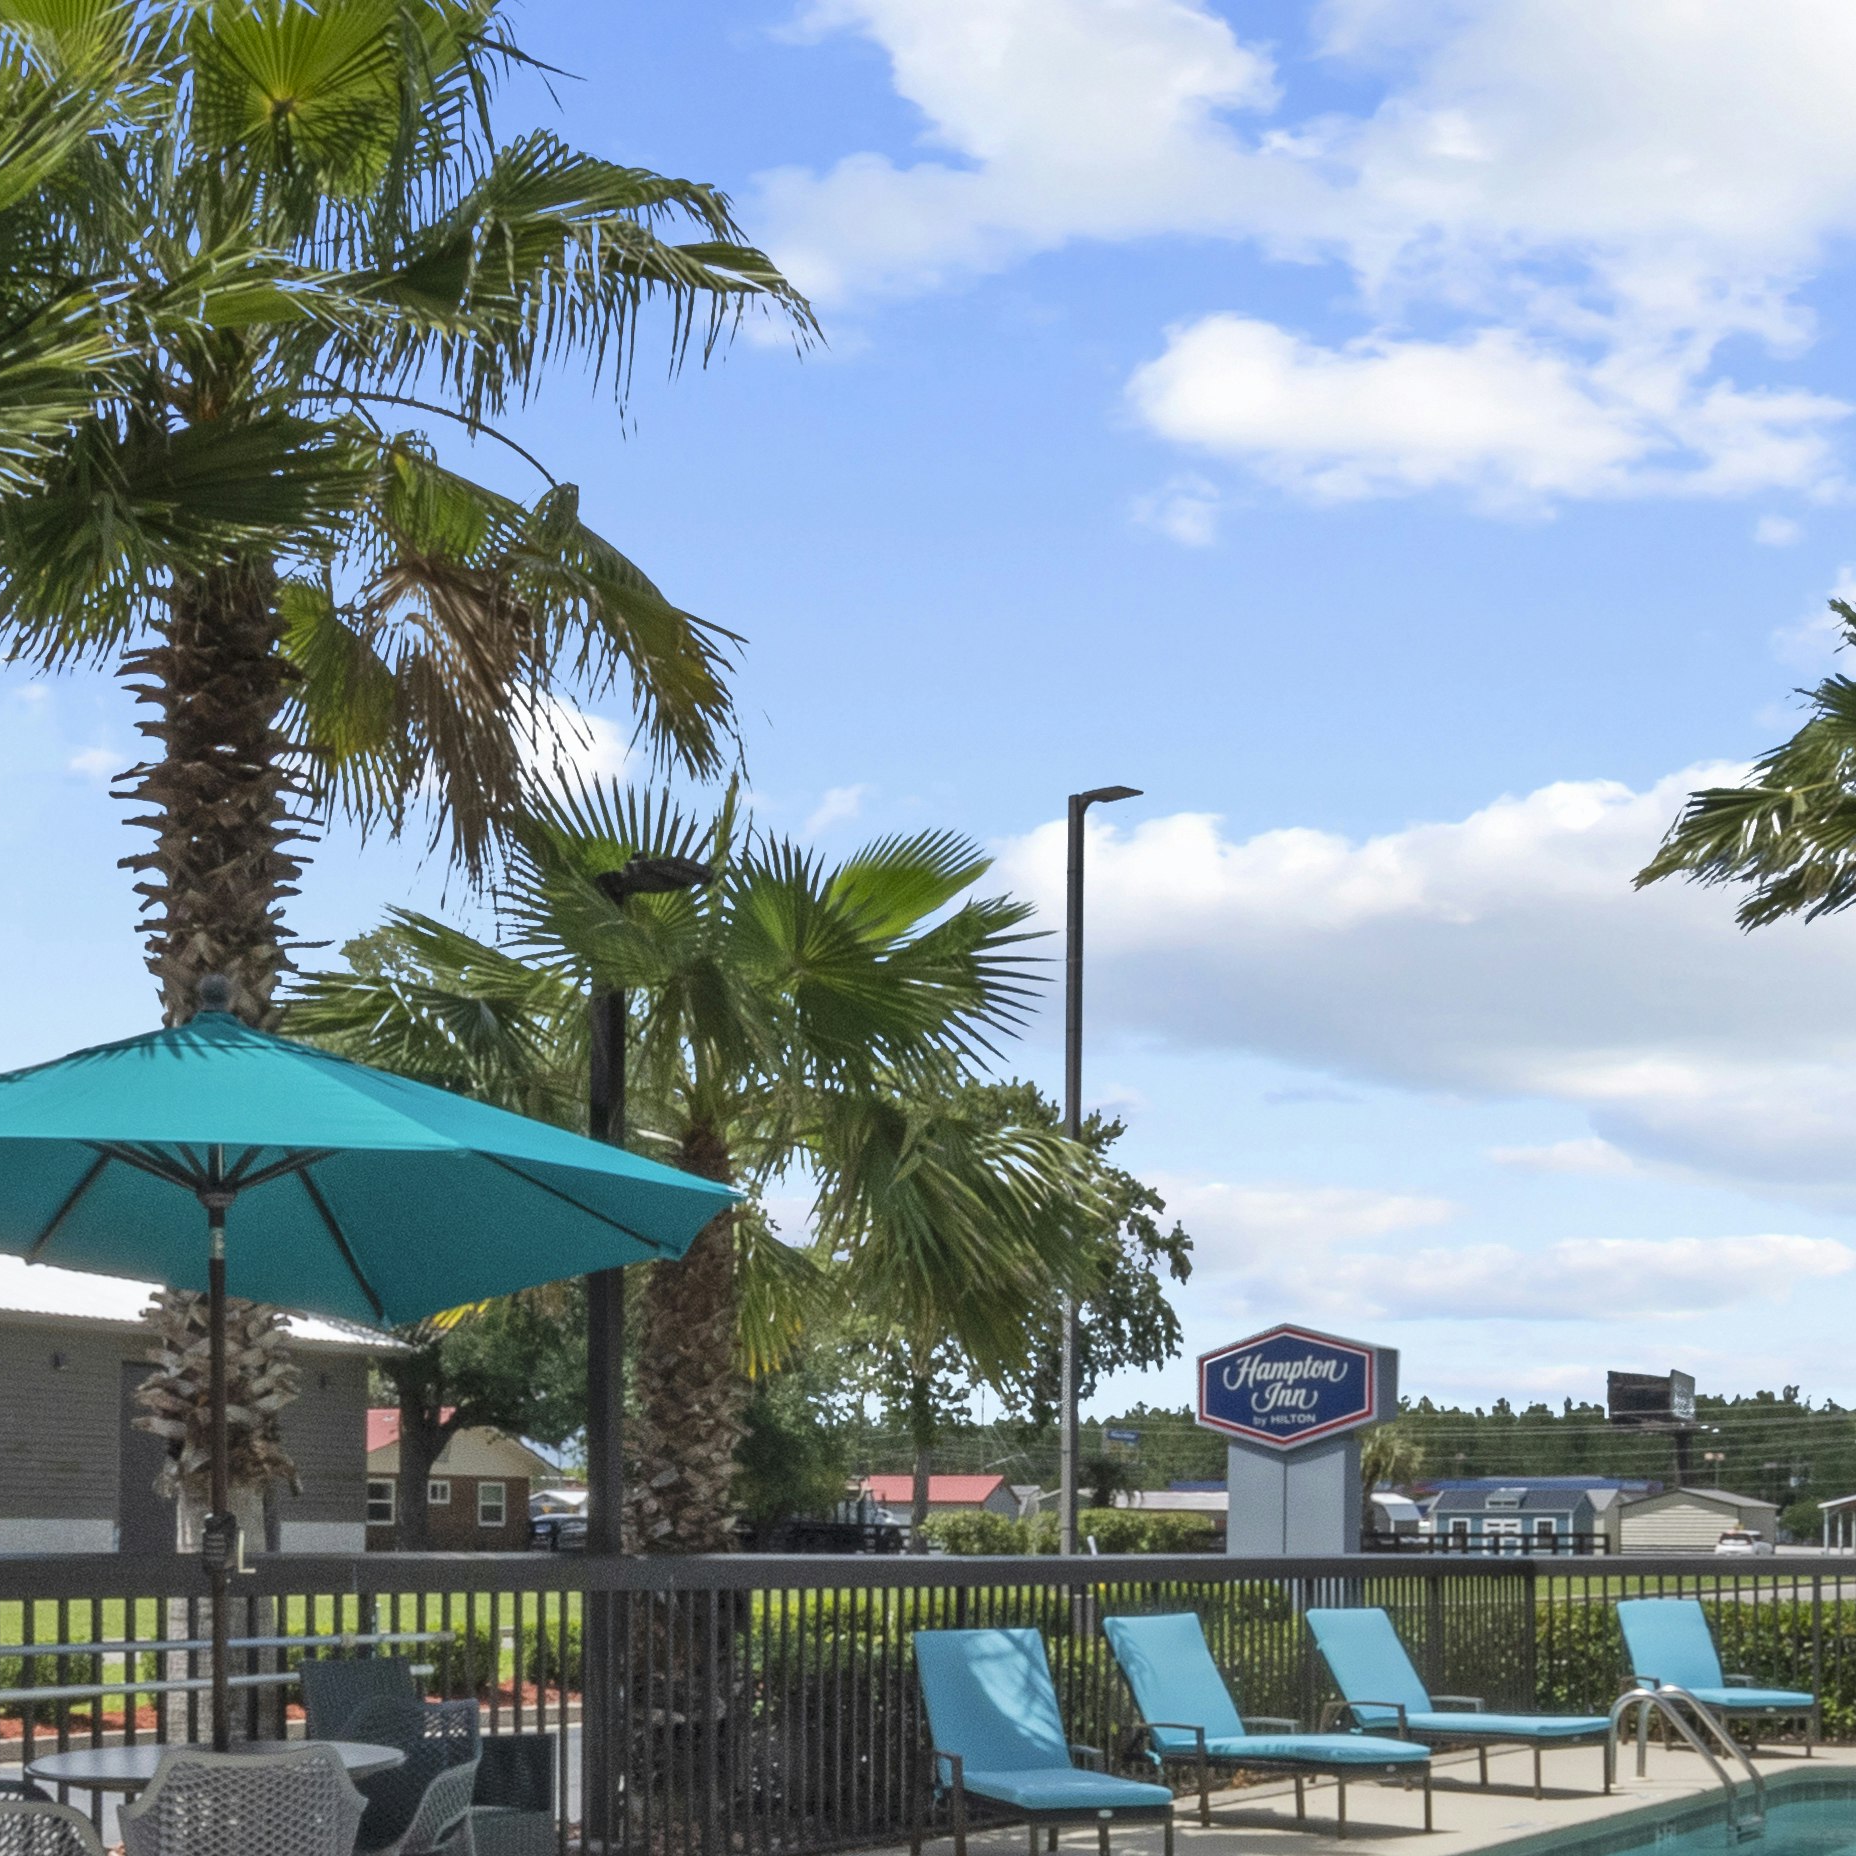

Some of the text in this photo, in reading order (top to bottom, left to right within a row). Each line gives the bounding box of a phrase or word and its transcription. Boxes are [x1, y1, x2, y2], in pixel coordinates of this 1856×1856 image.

[1223, 1353, 1348, 1390] Hampton
[1251, 1382, 1318, 1413] Inn
[1253, 1413, 1316, 1427] by HILTON
